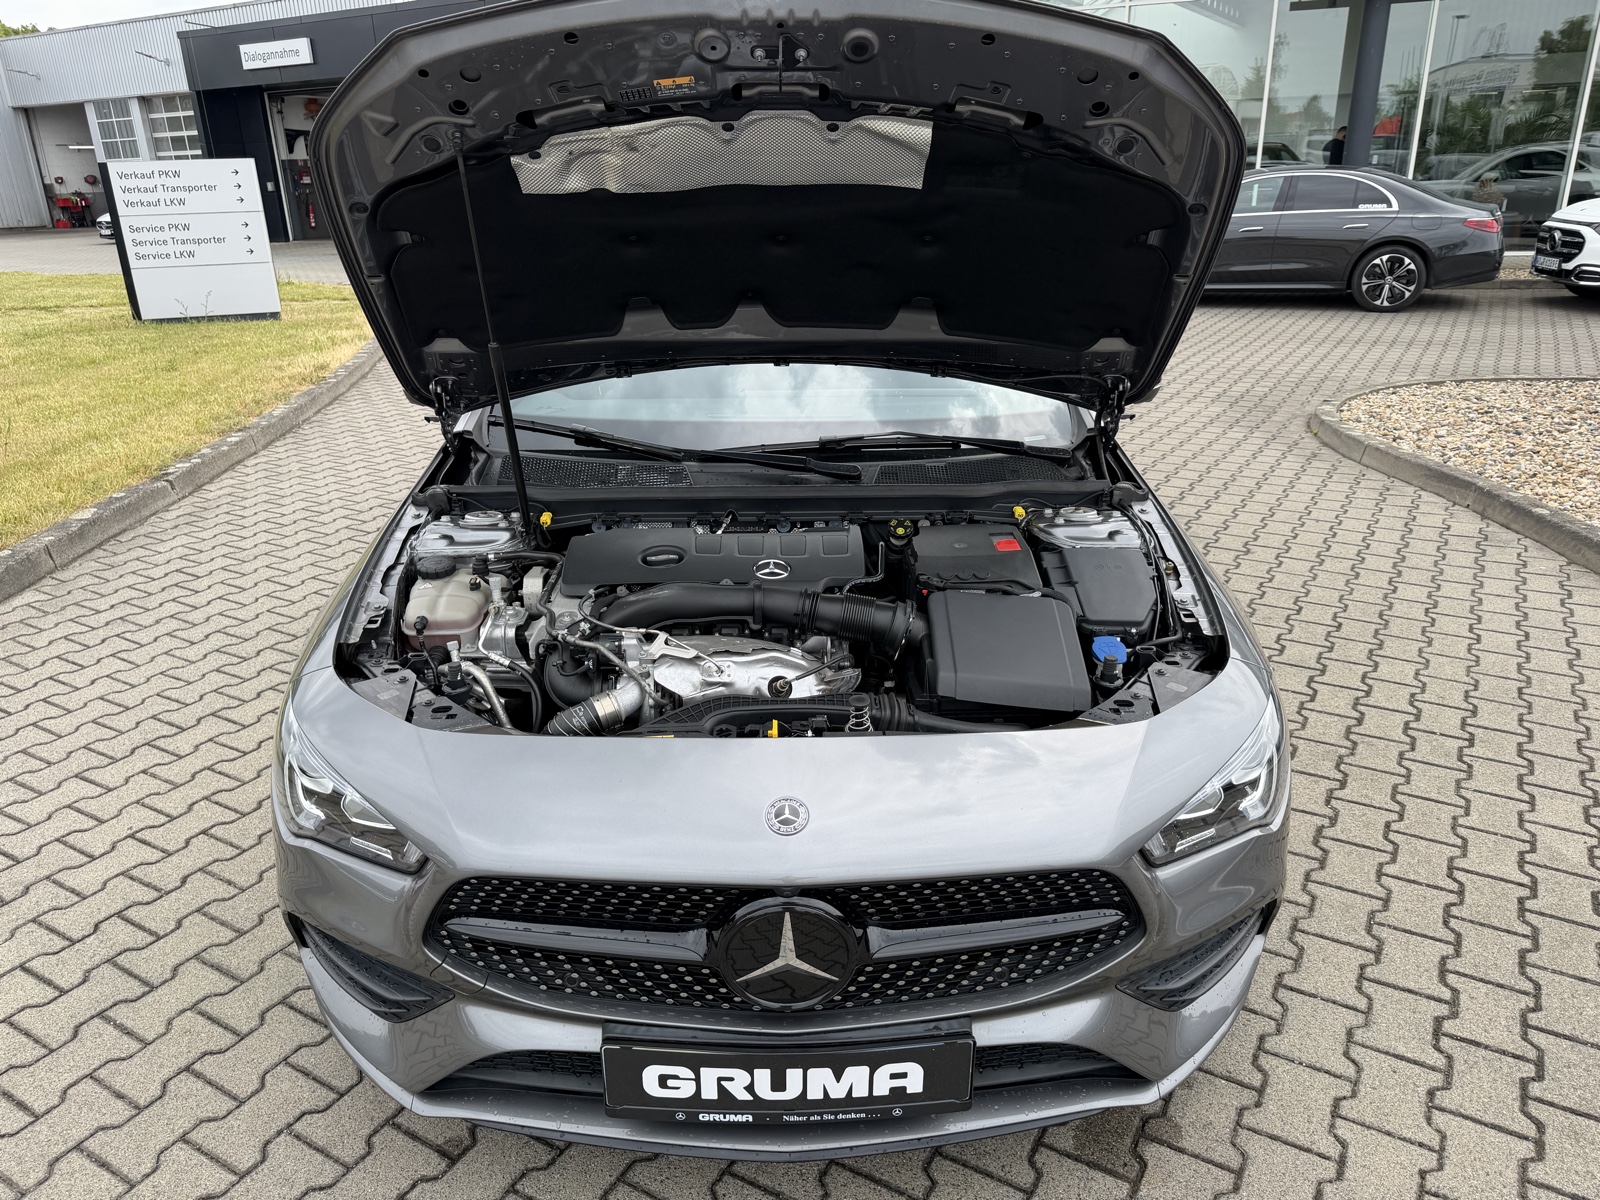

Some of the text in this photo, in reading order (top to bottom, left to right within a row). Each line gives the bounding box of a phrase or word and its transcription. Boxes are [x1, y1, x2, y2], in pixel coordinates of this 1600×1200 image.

[243, 48, 300, 63] Dialogannahme
[116, 169, 181, 180] Verkauf PKW
[119, 183, 218, 194] Verkauf Transporter
[122, 197, 186, 208] Verkauf LKW
[128, 222, 191, 234] Service PKW
[131, 236, 226, 248] Service Transporter
[134, 250, 196, 261] Service LKW
[642, 1062, 924, 1100] GRUMA
[698, 1113, 753, 1122] GRUMA
[782, 1114, 808, 1122] Näher
